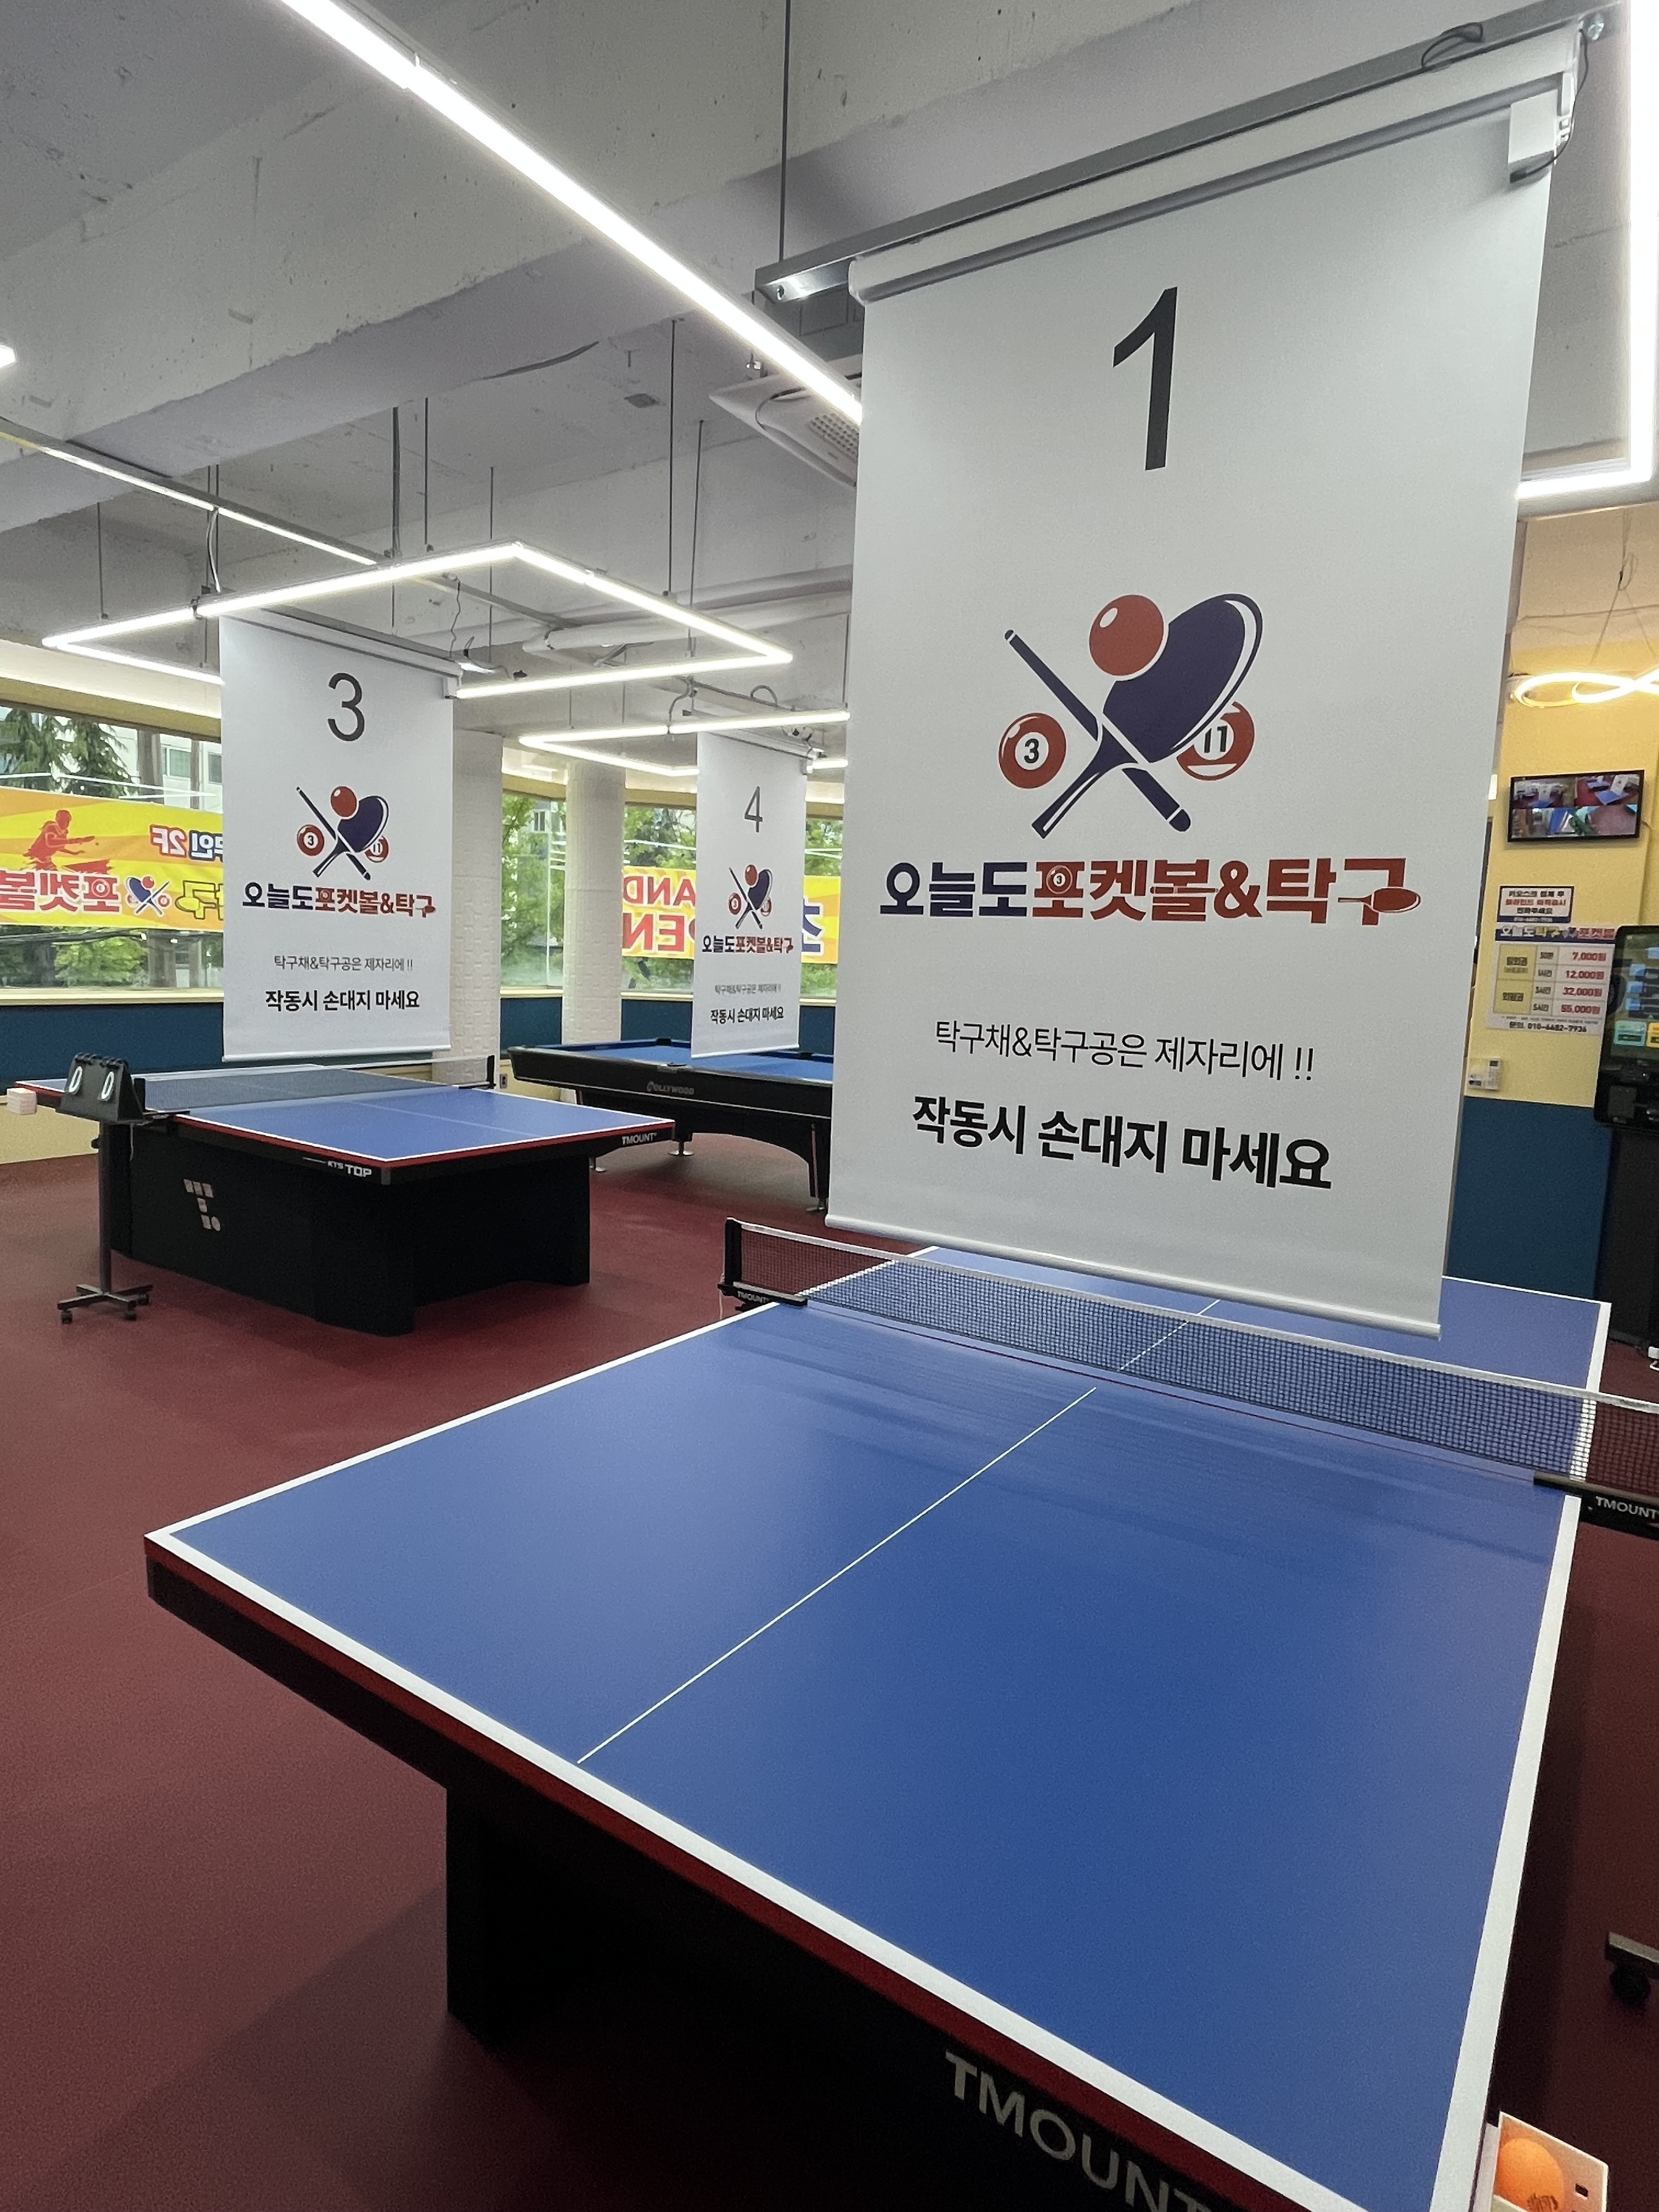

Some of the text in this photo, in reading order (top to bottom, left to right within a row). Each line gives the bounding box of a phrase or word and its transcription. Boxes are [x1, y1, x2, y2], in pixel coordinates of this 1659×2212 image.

[1113, 287, 1177, 471] 1
[328, 673, 365, 741] 3
[1024, 738, 1039, 764] 3
[744, 786, 763, 832] 4
[274, 956, 362, 971] 탁구채&탁구공은
[364, 958, 404, 971] 제자리에
[1572, 951, 1606, 961] 7,000원
[1566, 970, 1604, 980] 12,000원
[266, 990, 420, 1012] 작동시 손대지 마세요
[1562, 987, 1602, 997] 32,000원
[710, 1006, 784, 1024] 작동시 손대지 마세요
[934, 1020, 1147, 1068] 탁구채&탁구공은
[1154, 1036, 1284, 1081] 제자리에
[101, 1071, 114, 1099] 0
[912, 1095, 1332, 1189] 작동시 손대지 마세요
[345, 1164, 372, 1177] TOP
[1595, 1496, 1657, 1519] TMOUNT
